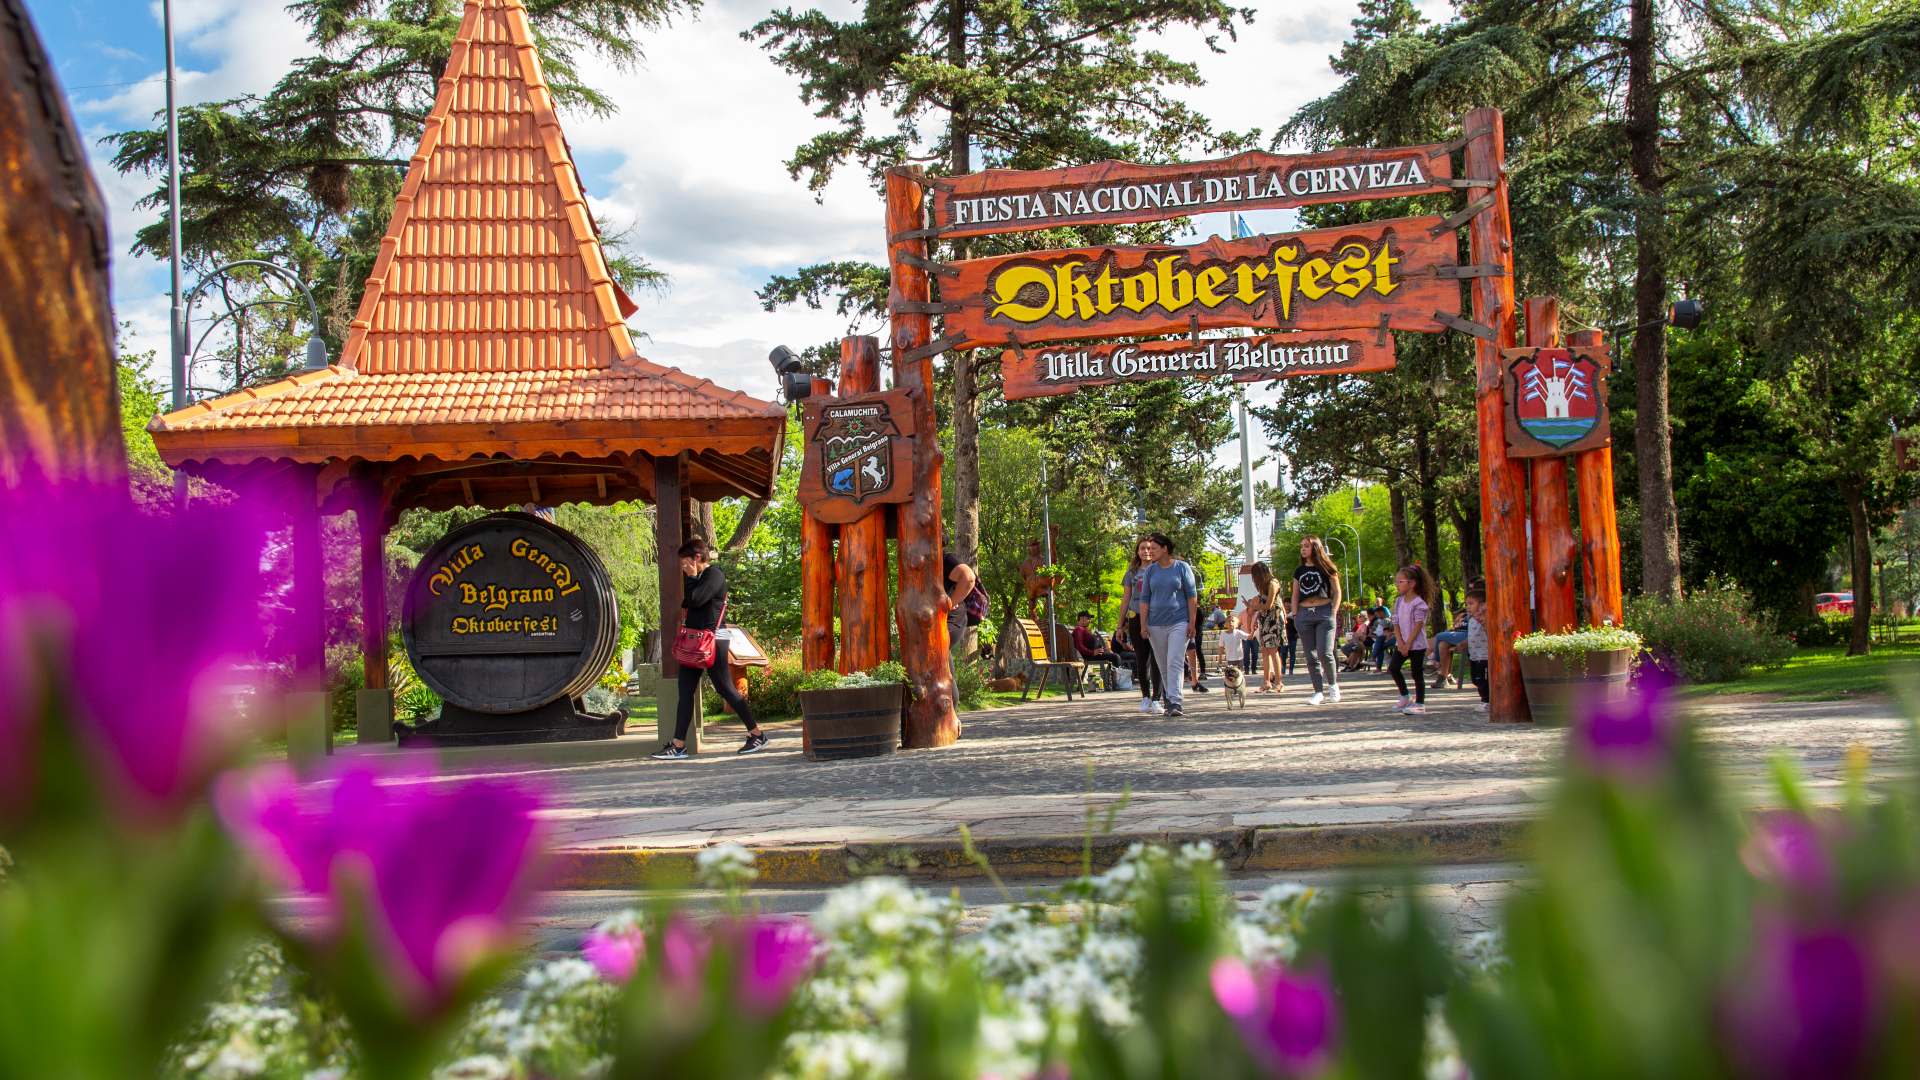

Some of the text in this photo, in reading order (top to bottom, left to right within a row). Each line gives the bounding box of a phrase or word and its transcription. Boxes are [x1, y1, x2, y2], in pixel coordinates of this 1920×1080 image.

[953, 160, 1427, 225] FIESTA NACIONAL DE LA CERVEZA
[991, 240, 1401, 323] Oktoberfest
[1042, 342, 1350, 381] Villa General Belgrano
[830, 408, 878, 418] CALAMUCHITA
[840, 449, 862, 464] General
[862, 435, 888, 452] Belgrano
[429, 538, 582, 597] Villa General
[459, 583, 554, 613] Belgrano
[451, 615, 558, 635] Oktoberfest
